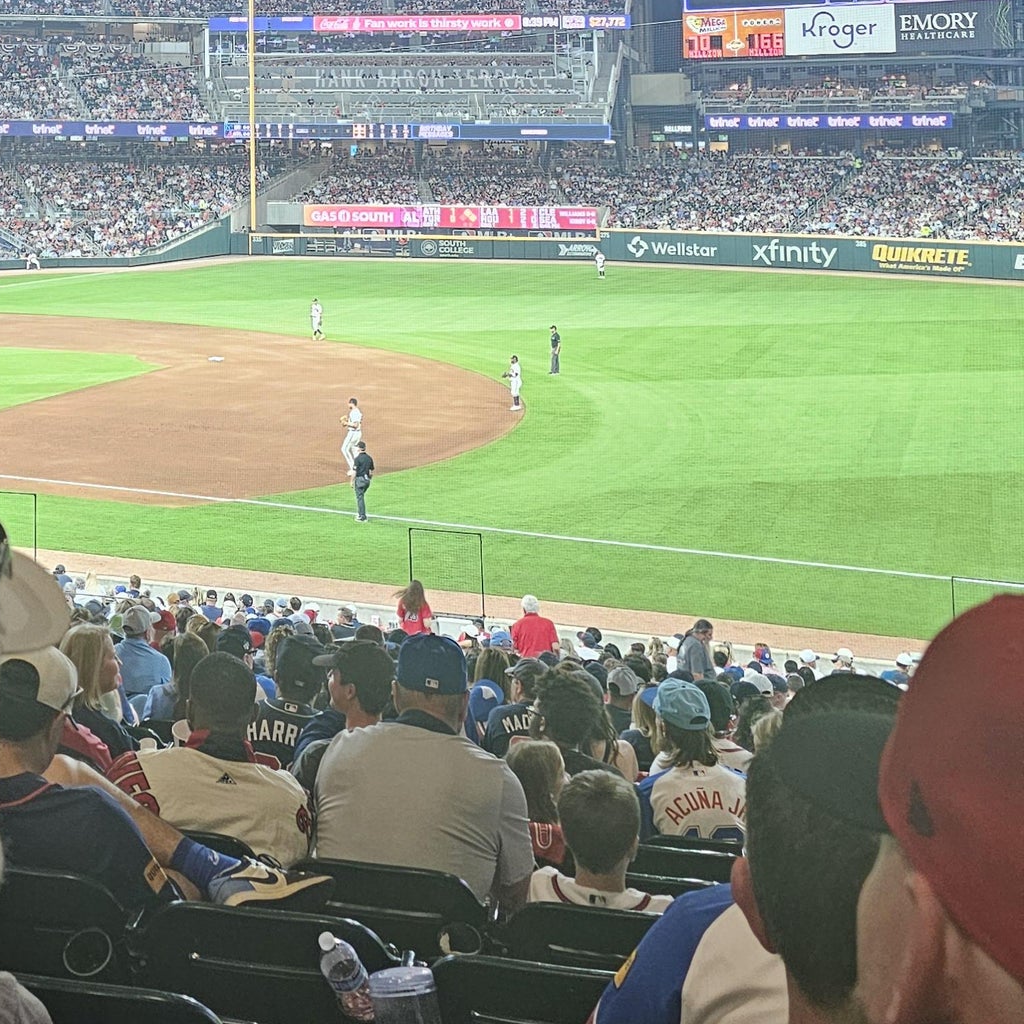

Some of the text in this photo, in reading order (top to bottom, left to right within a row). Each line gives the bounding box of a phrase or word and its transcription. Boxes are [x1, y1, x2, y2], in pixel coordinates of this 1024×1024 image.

[364, 17, 501, 30] Fan work is thirsty work
[544, 17, 559, 26] PM
[701, 18, 726, 27] MEGA
[899, 12, 978, 31] EMORY
[802, 11, 877, 48] Kroger
[901, 30, 975, 40] HEALTHCARE
[754, 34, 783, 49] 166
[748, 48, 783, 56] MILLION
[315, 69, 553, 88] HANK AARON TERRACE
[710, 117, 740, 128] trinet
[748, 117, 780, 128] trinet
[787, 117, 819, 127] trinet
[828, 117, 861, 127] trinet
[869, 116, 903, 127] trinet
[912, 115, 947, 126] trinet
[32, 124, 63, 135] trinet
[85, 124, 115, 135] trinet
[137, 125, 167, 136] trinet
[188, 125, 218, 136] trinet
[311, 211, 394, 222] GAS SOUTH
[423, 207, 440, 215] ATH
[403, 212, 419, 223] AL
[439, 246, 474, 254] COLLEGE
[651, 241, 717, 257] Wellstar
[753, 239, 838, 268] xfinity
[872, 244, 970, 265] QUIKRETE
[898, 263, 930, 271] America's
[665, 787, 724, 826] ACUÑA
